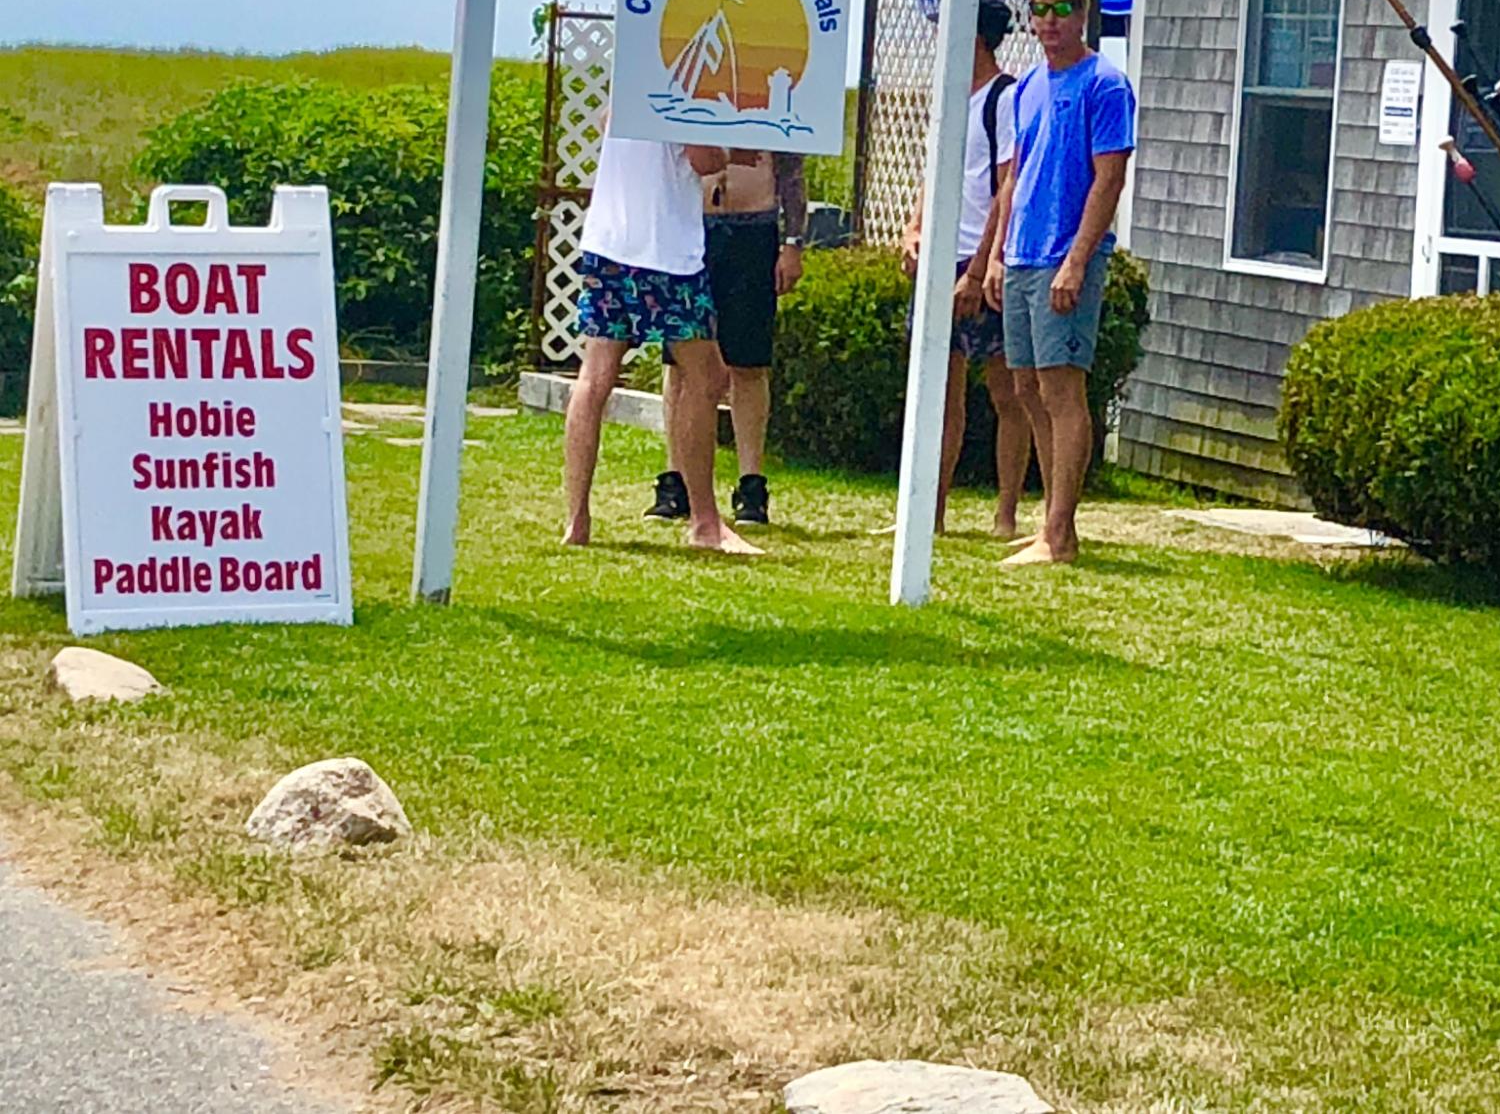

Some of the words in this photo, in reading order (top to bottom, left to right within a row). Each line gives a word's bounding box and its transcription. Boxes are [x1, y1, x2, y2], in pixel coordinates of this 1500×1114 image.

[128, 262, 267, 316] BOAT
[84, 327, 315, 380] RENTALS
[149, 400, 256, 437] Hobie
[133, 451, 275, 489] Sunfish
[151, 503, 263, 547] Kayak
[94, 556, 212, 594] Paddle
[220, 554, 322, 592] Board
